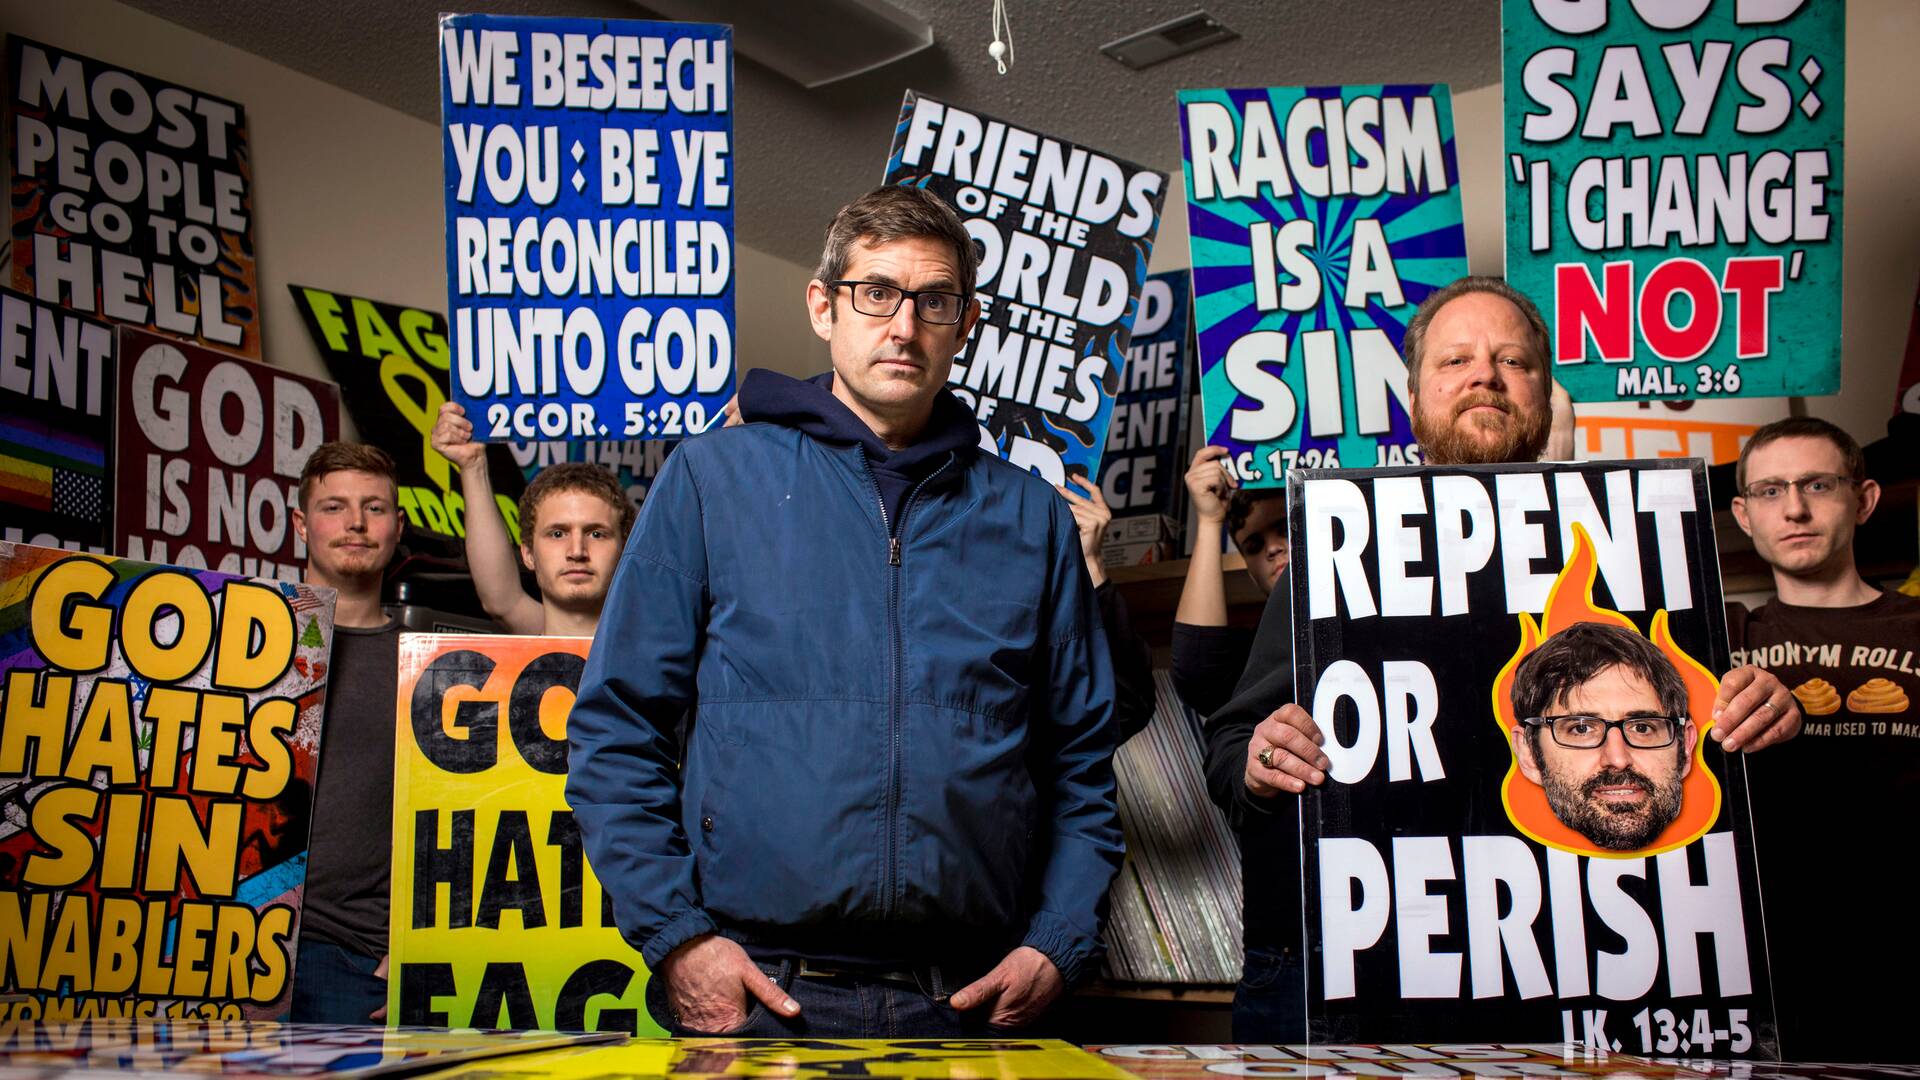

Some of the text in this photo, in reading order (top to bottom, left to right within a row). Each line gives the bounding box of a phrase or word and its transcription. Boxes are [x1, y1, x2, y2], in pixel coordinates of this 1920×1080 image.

[19, 44, 235, 160] MOST
[444, 28, 726, 112] WE BESEECH
[1522, 38, 1822, 142] SAYS:
[17, 115, 247, 232] PEOPLE
[449, 123, 558, 204] YOU
[601, 128, 660, 205] BE
[671, 130, 729, 206] YE
[902, 98, 1162, 238] FRIENDS
[1187, 95, 1448, 200] RACISM
[50, 193, 219, 265] GO TO
[956, 186, 1089, 248] OF THE
[1567, 150, 1829, 250] CHANGE
[34, 234, 243, 346] HELL
[457, 217, 730, 296] RECONCILED
[974, 218, 1129, 326] ORLD
[1250, 219, 1321, 312] IS
[1344, 218, 1405, 308] A
[457, 307, 732, 396] UNTO GOD
[949, 324, 1108, 422] MIES
[1007, 303, 1077, 344] THE
[132, 344, 324, 479] GOD
[487, 402, 705, 437] 2COR. 5:20
[1224, 328, 1411, 442] SIN
[1617, 364, 1740, 396] MAL. 3:6
[146, 454, 191, 536] IS
[1303, 469, 1697, 621] REPENT
[30, 559, 295, 691] GOD
[1850, 645, 1920, 677] ROLL
[0, 672, 297, 799] HATES
[410, 650, 585, 774] GO
[1312, 660, 1445, 784] OR
[1835, 722, 1866, 736] USED
[1872, 722, 1886, 735] TO
[23, 786, 243, 897] SIN
[0, 892, 294, 1002] NABLERS
[1318, 831, 1752, 1000] PERISH
[1633, 1007, 1752, 1053] 13:4-5
